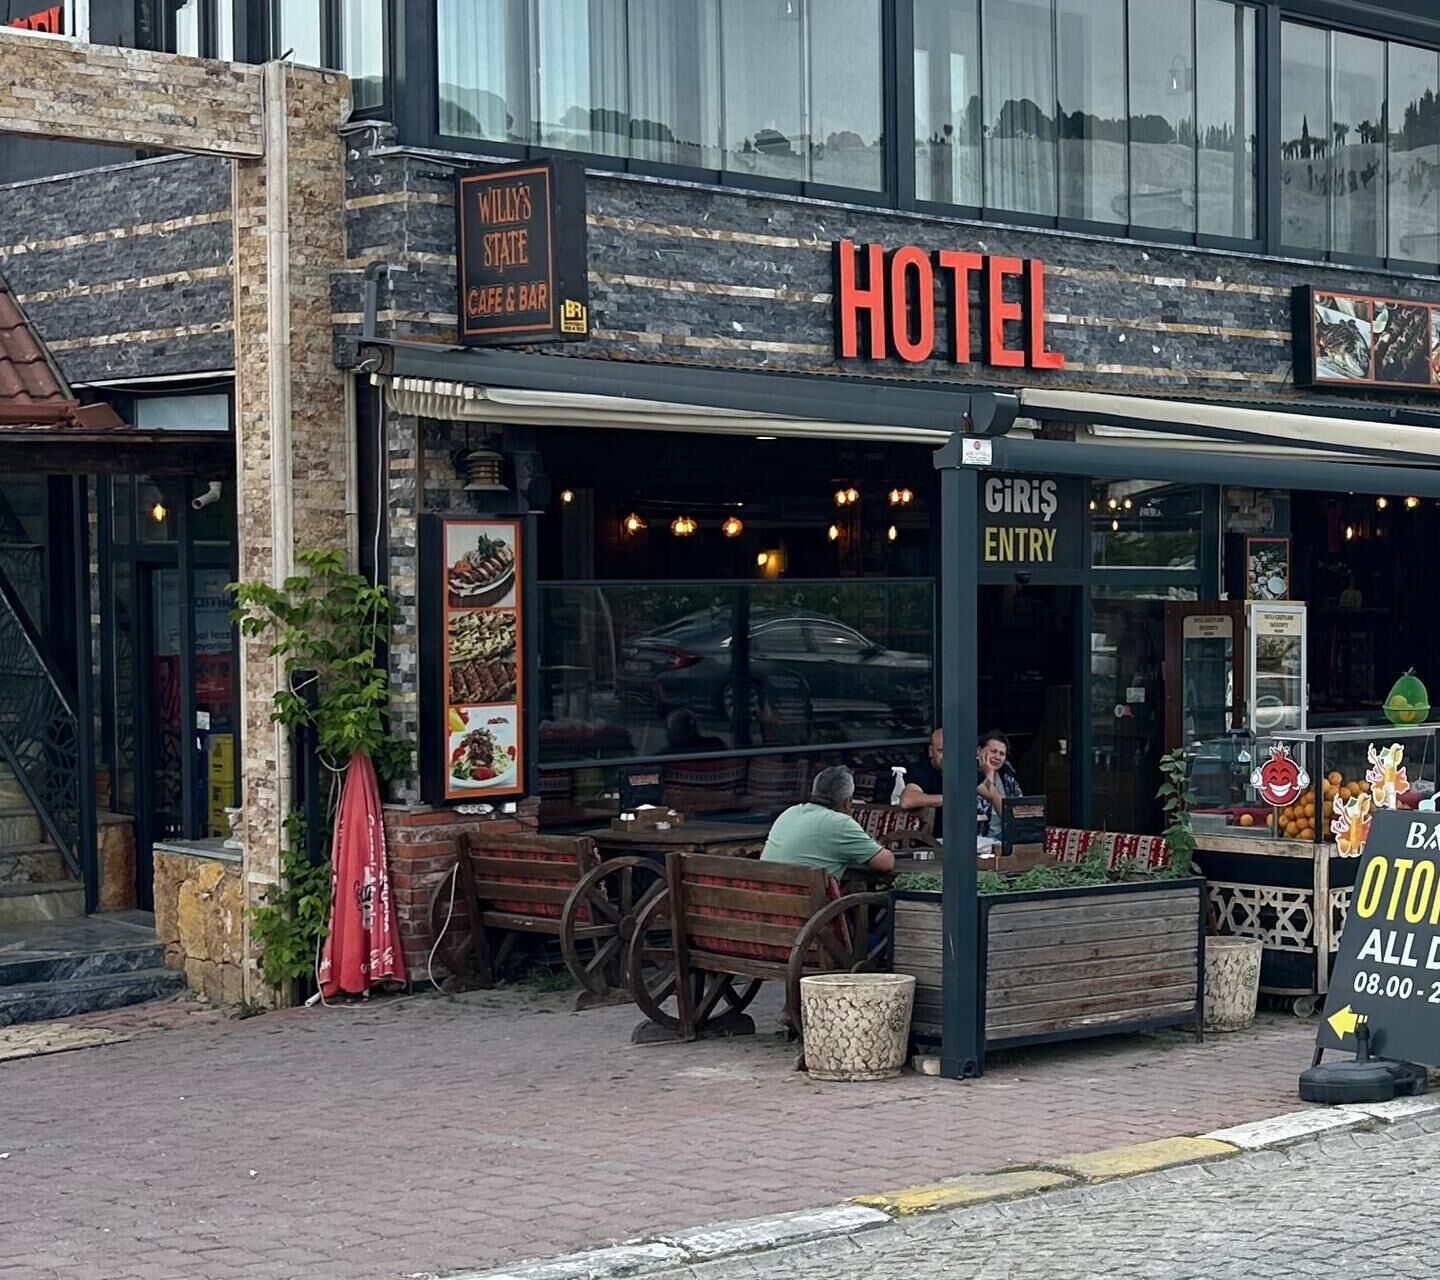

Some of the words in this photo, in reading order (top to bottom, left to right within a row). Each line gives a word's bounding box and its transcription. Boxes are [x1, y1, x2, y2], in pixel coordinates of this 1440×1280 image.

[477, 182, 532, 224] WILLY'S
[483, 228, 529, 272] STATE
[467, 287, 503, 316] CAFE
[505, 285, 515, 313] &
[519, 282, 548, 312] BAR
[837, 239, 1065, 369] HOTEL
[985, 526, 1057, 561] ENTRY
[1356, 928, 1418, 967] ALL
[1353, 971, 1413, 999] 08.00
